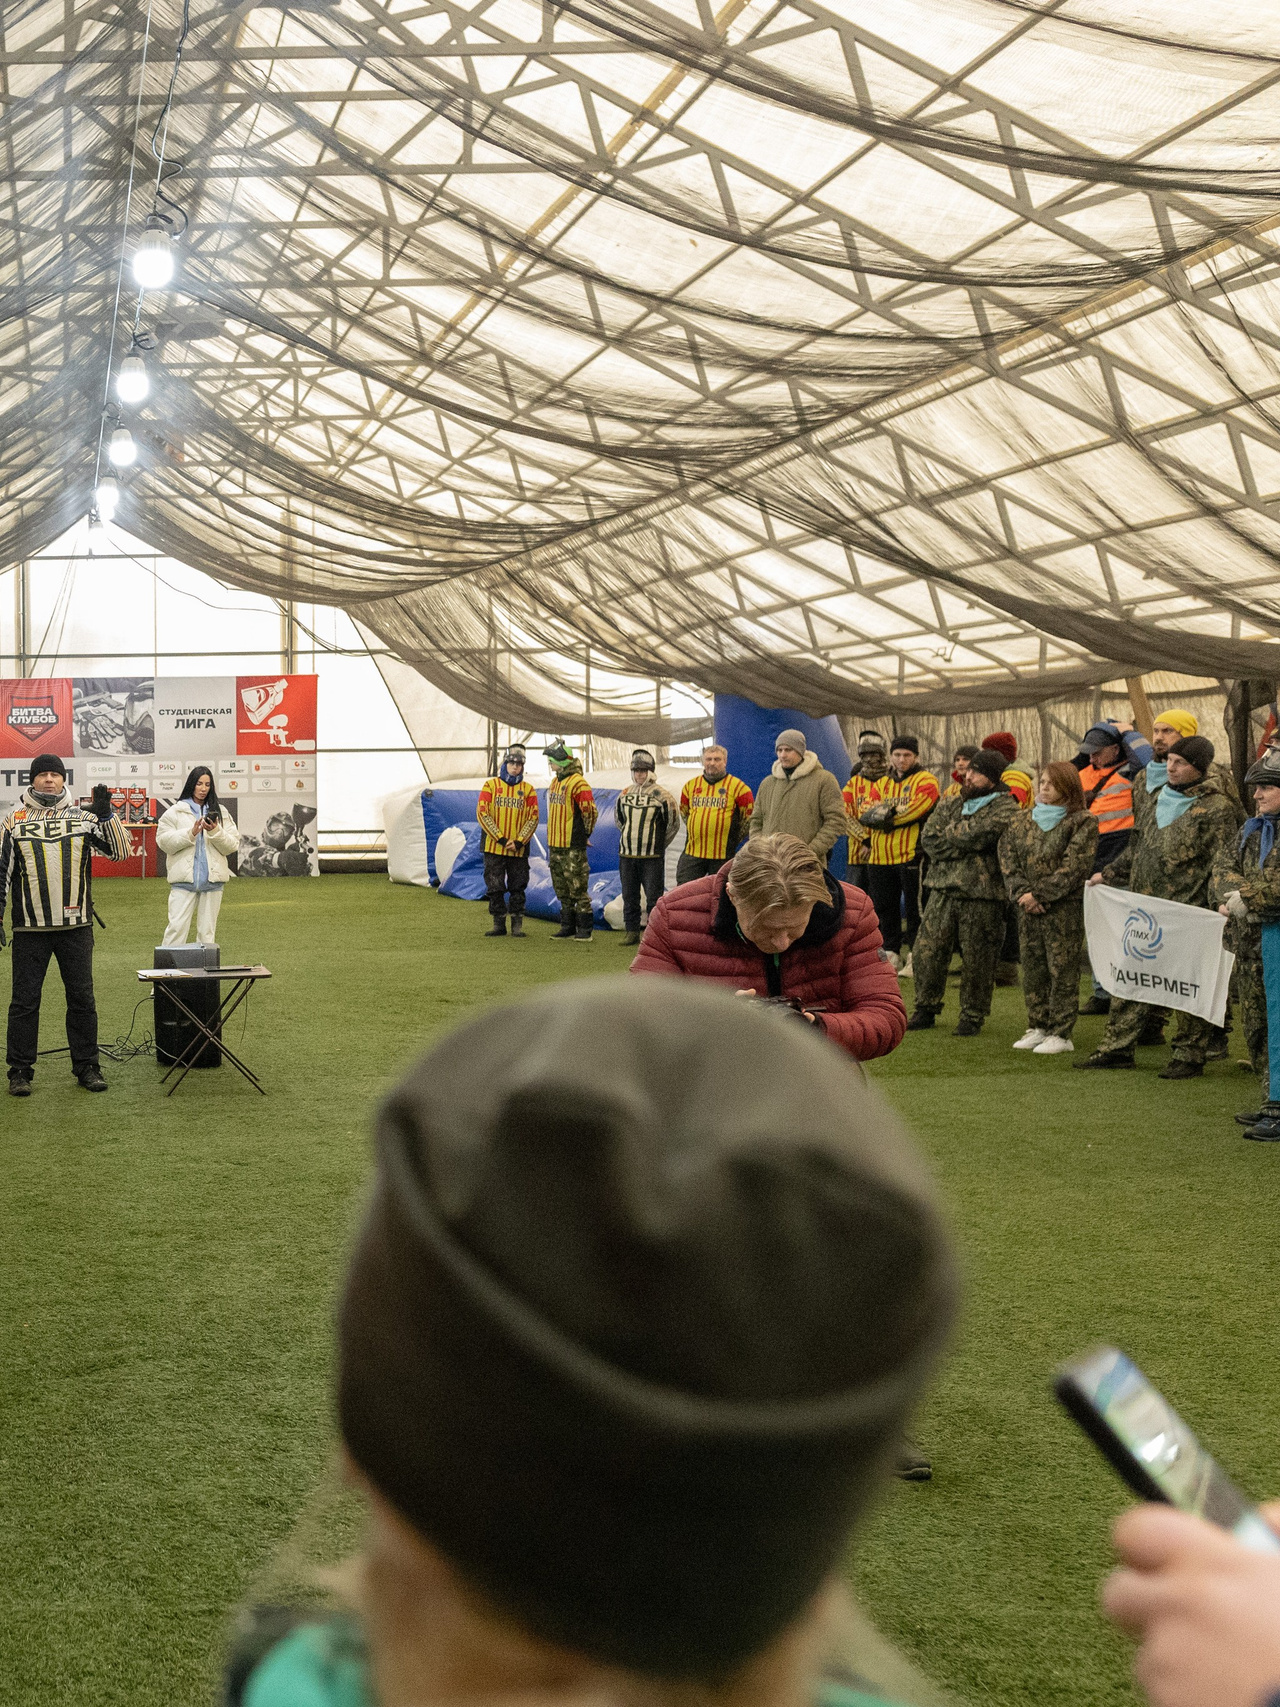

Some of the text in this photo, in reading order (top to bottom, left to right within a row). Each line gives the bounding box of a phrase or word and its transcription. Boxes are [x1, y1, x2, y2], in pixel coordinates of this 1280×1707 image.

[12, 708, 53, 716] БИТВА
[158, 708, 232, 716] СТУДЕНЧЕСКАЯ
[8, 716, 57, 724] КЛУБОВ
[174, 718, 216, 729] ЛИГА
[625, 795, 655, 806] REF
[692, 796, 727, 808] REFEREE
[20, 820, 82, 838] REF
[1130, 929, 1150, 940] ПМХ
[1110, 963, 1200, 999] АЧЕРМЕТ
